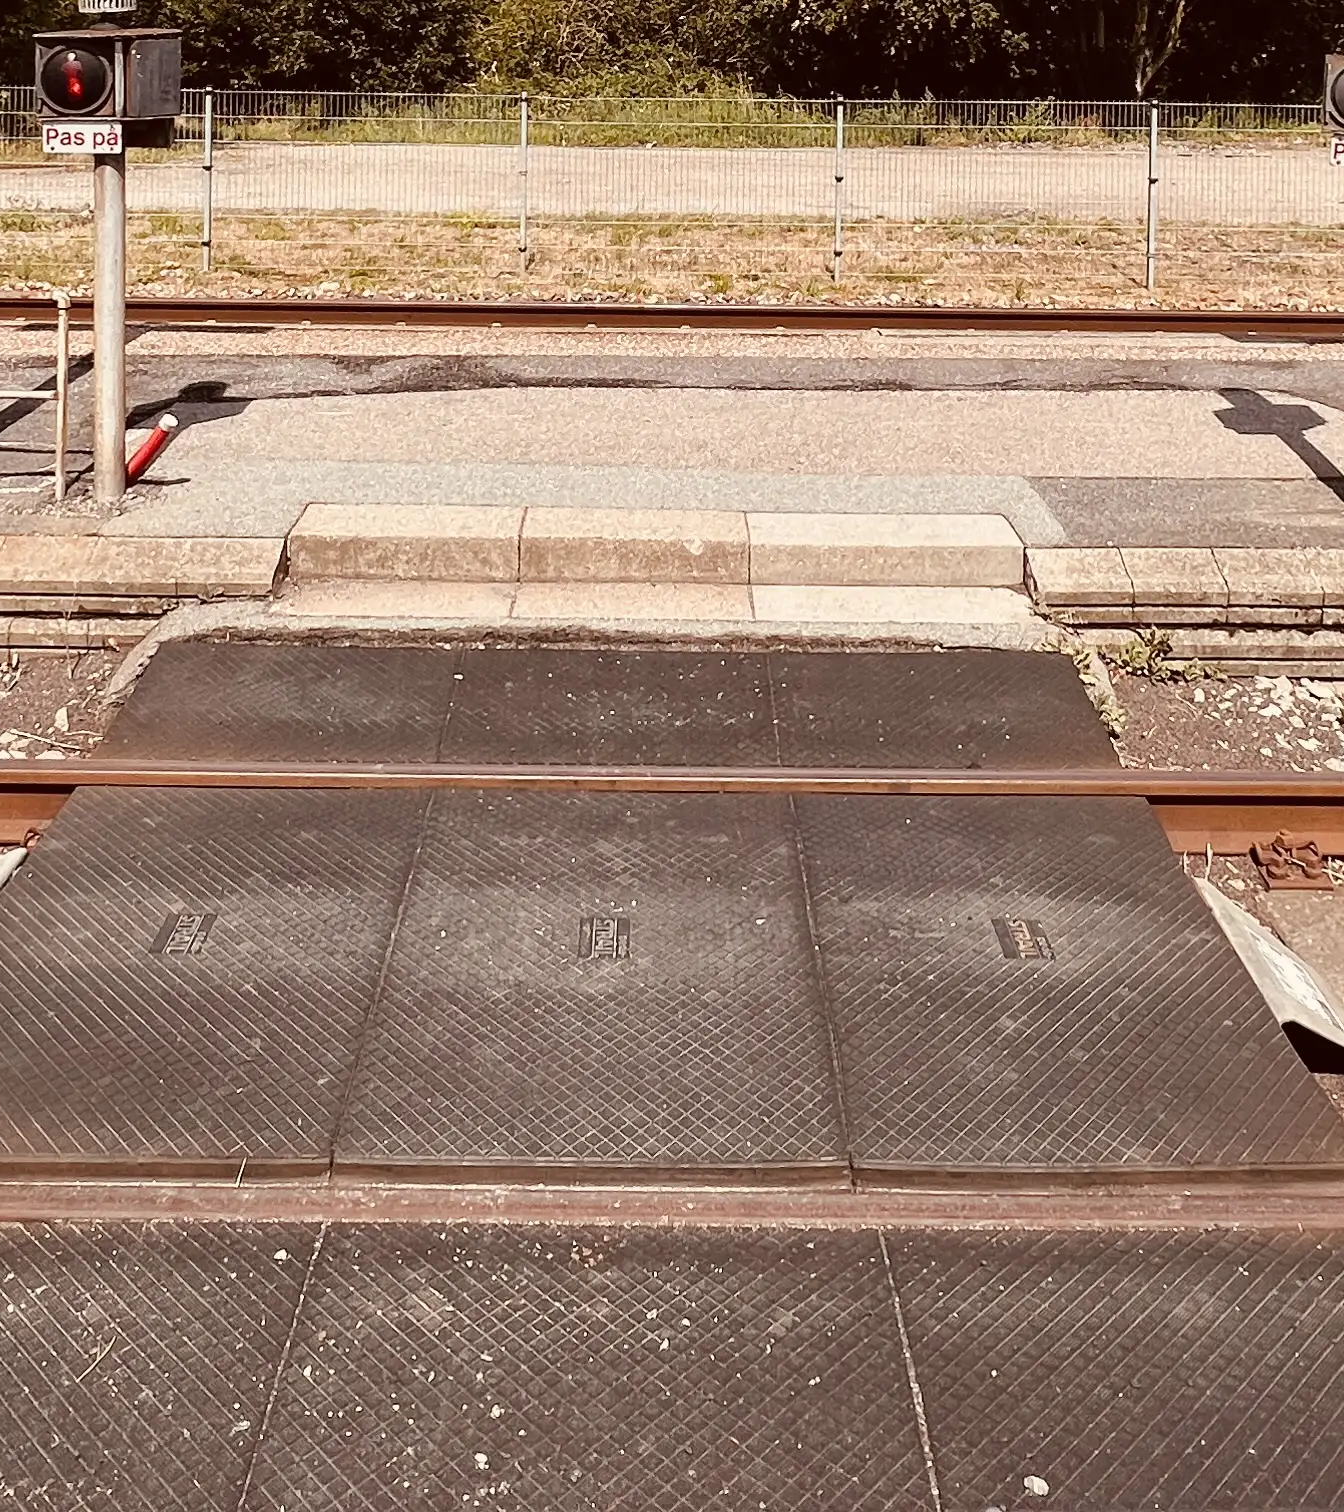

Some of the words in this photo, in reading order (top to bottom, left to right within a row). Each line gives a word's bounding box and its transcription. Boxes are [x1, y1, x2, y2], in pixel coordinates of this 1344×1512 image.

[46, 128, 85, 146] Pas
[93, 126, 118, 149] på
[166, 915, 201, 954] STRAIL
[1008, 920, 1038, 959] STRAIL
